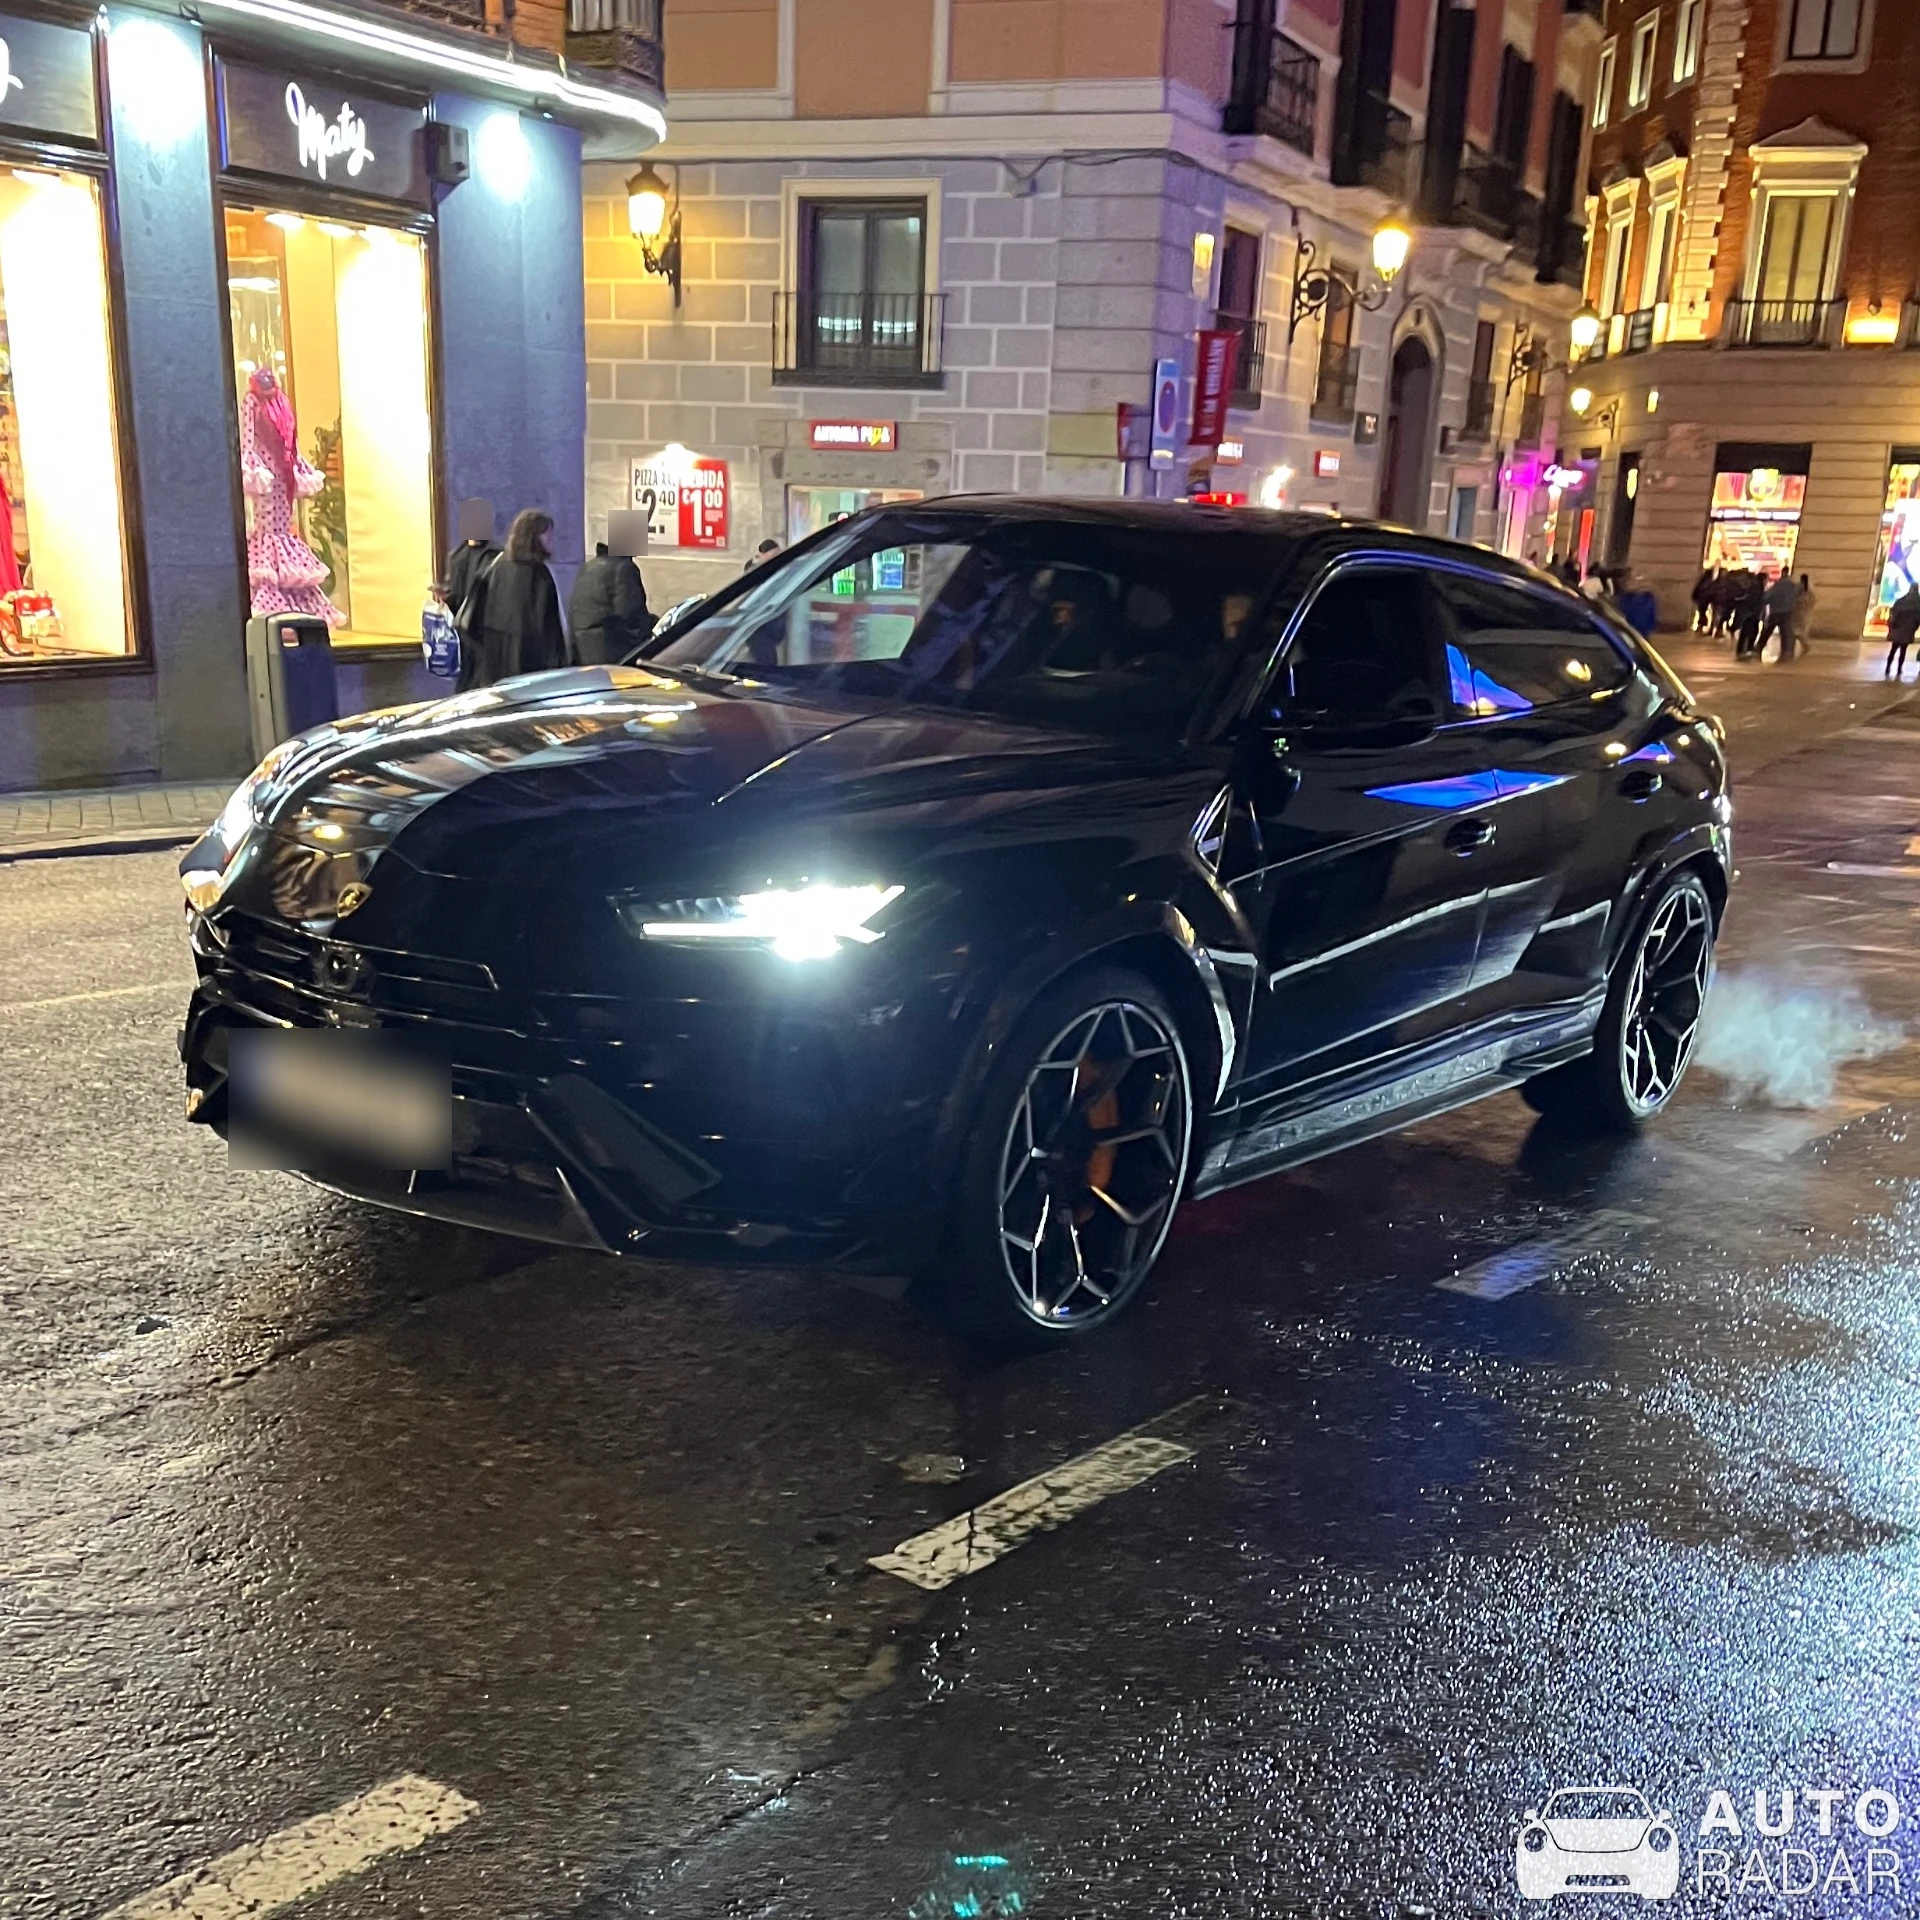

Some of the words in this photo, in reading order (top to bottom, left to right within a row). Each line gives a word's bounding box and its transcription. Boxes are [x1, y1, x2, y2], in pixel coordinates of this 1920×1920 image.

[285, 82, 375, 180] Maty
[635, 469, 658, 486] PIZZA
[681, 469, 724, 488] BIDA
